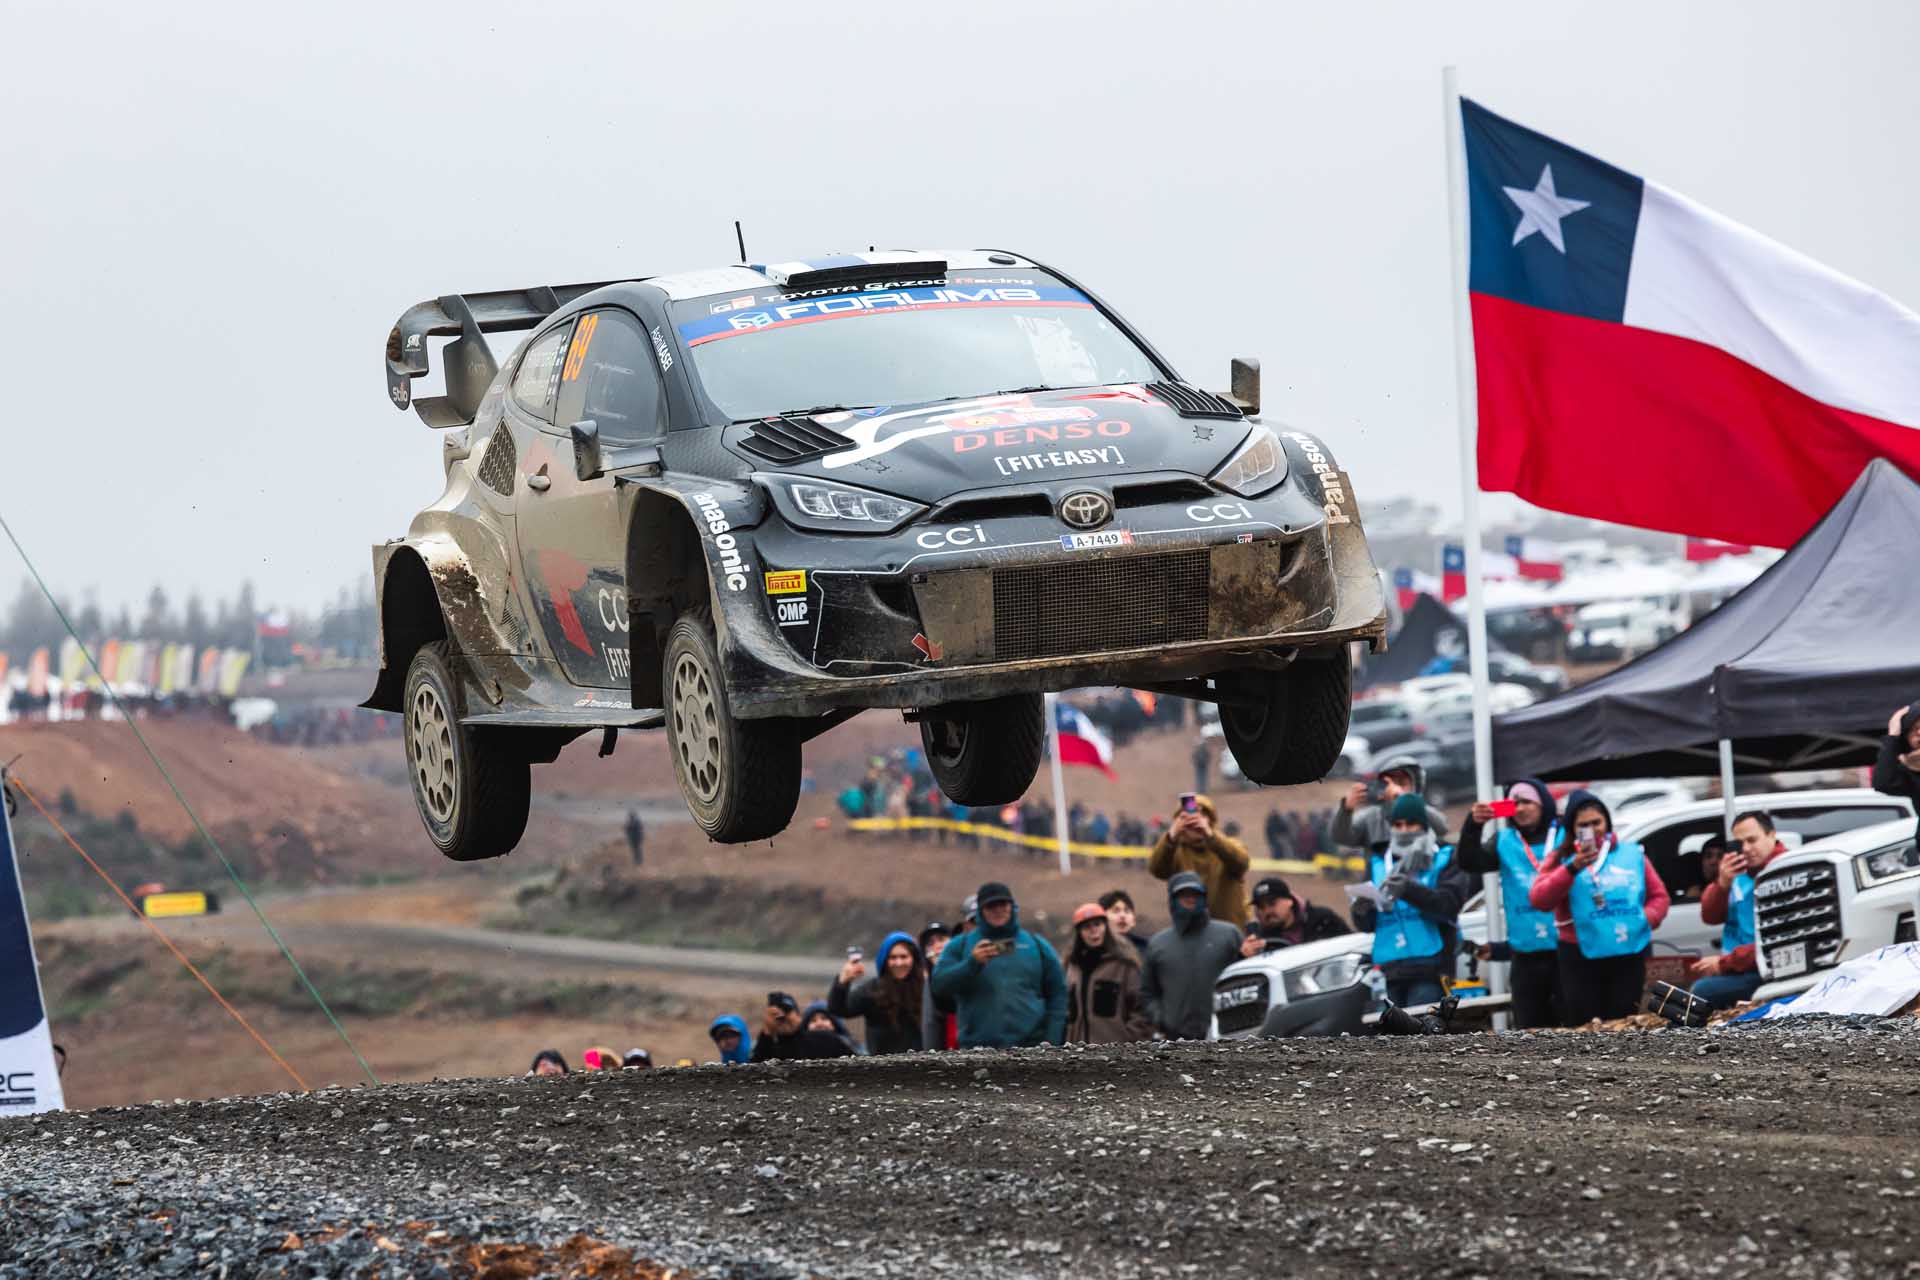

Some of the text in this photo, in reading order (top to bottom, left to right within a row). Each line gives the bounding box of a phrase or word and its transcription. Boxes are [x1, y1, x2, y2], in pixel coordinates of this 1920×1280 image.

[762, 277, 1035, 302] TOYOTA GAZOO Racing
[777, 289, 1041, 319] FORUM8
[953, 420, 1132, 453] DENSO
[917, 525, 987, 549] CCi
[1076, 534, 1120, 547] A-7449
[768, 575, 802, 590] PIRELLI
[777, 602, 808, 621] OMP
